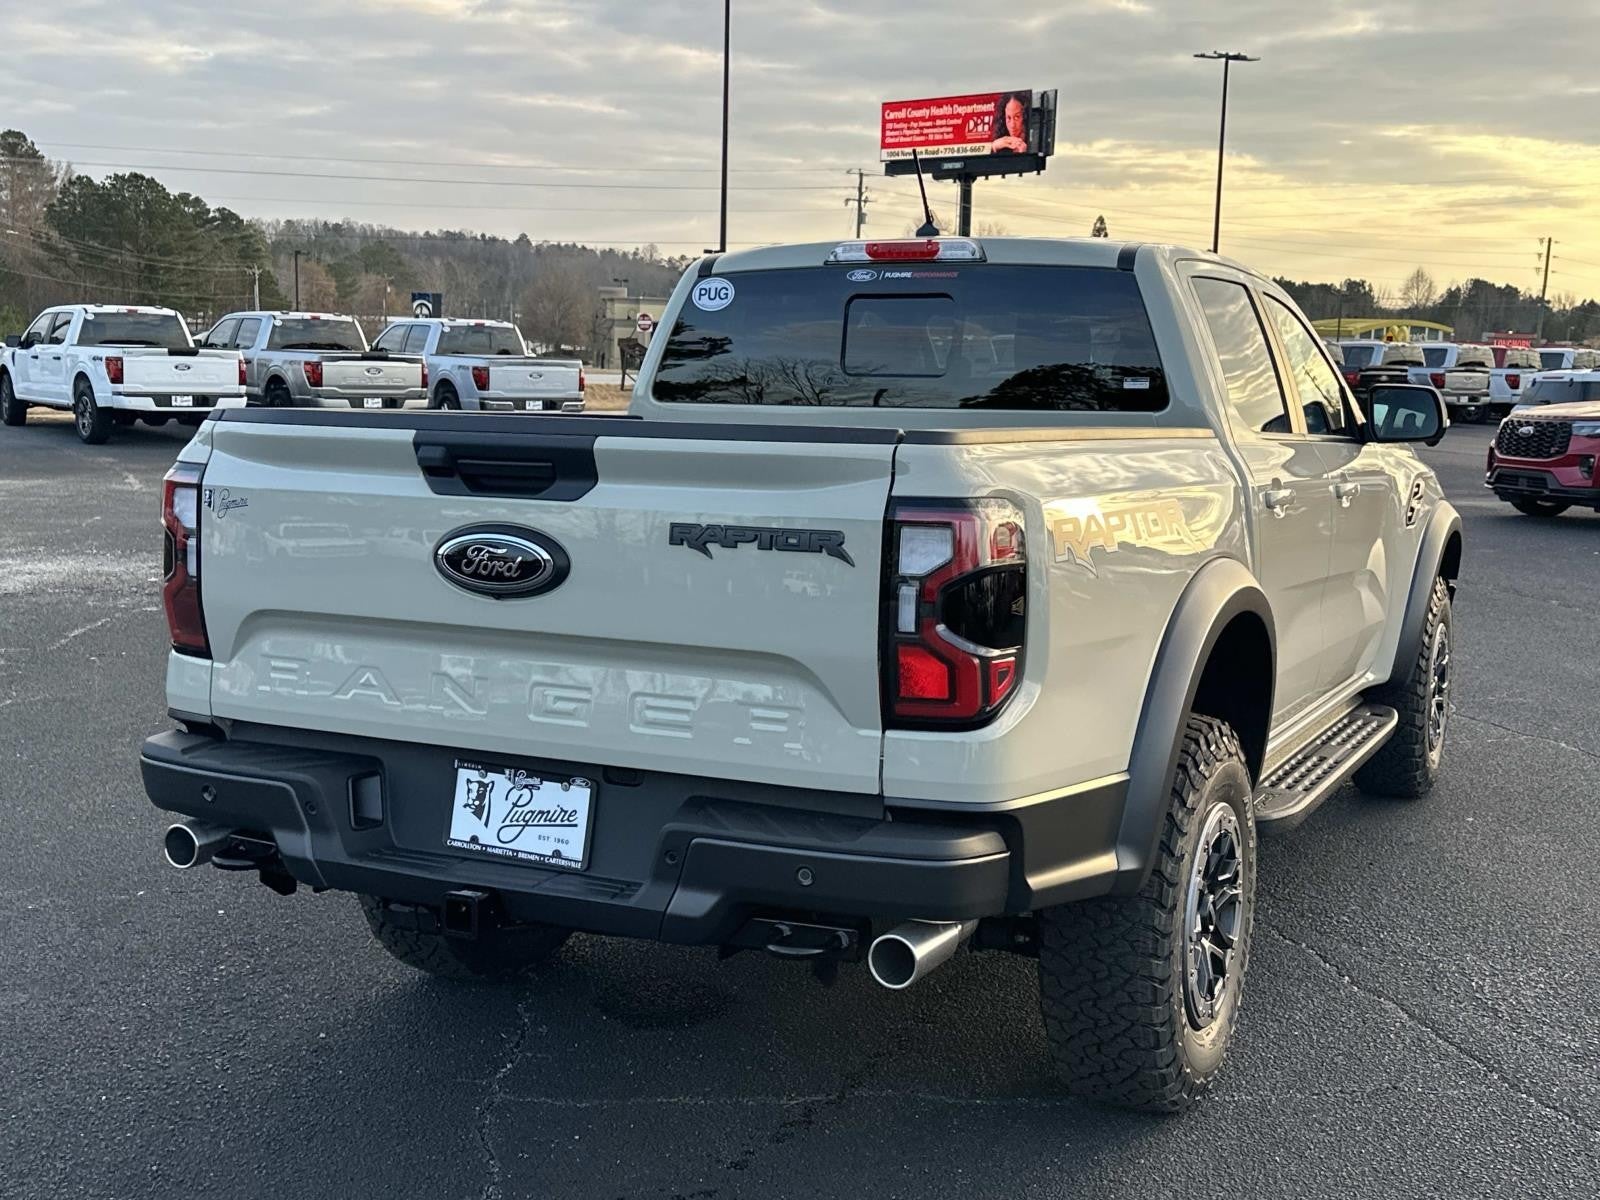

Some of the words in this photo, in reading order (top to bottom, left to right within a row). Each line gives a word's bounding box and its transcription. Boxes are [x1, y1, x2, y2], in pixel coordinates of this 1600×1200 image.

[885, 108, 907, 120] Carroll
[907, 106, 930, 119] County
[930, 104, 953, 116] Health
[953, 102, 995, 116] Department
[900, 149, 924, 157] Newan
[925, 148, 940, 156] Road
[698, 286, 729, 302] PUG
[668, 521, 856, 568] RAPTOR
[1053, 499, 1210, 579] RAPTOR
[460, 544, 523, 578] Ford
[497, 785, 579, 844] Pugmire
[446, 840, 482, 851] CARROLLTON
[486, 846, 513, 857] MARIETTA
[517, 851, 540, 861] BREMEN
[544, 856, 583, 869] CARTERSVILLE
[553, 837, 570, 845] 1960
